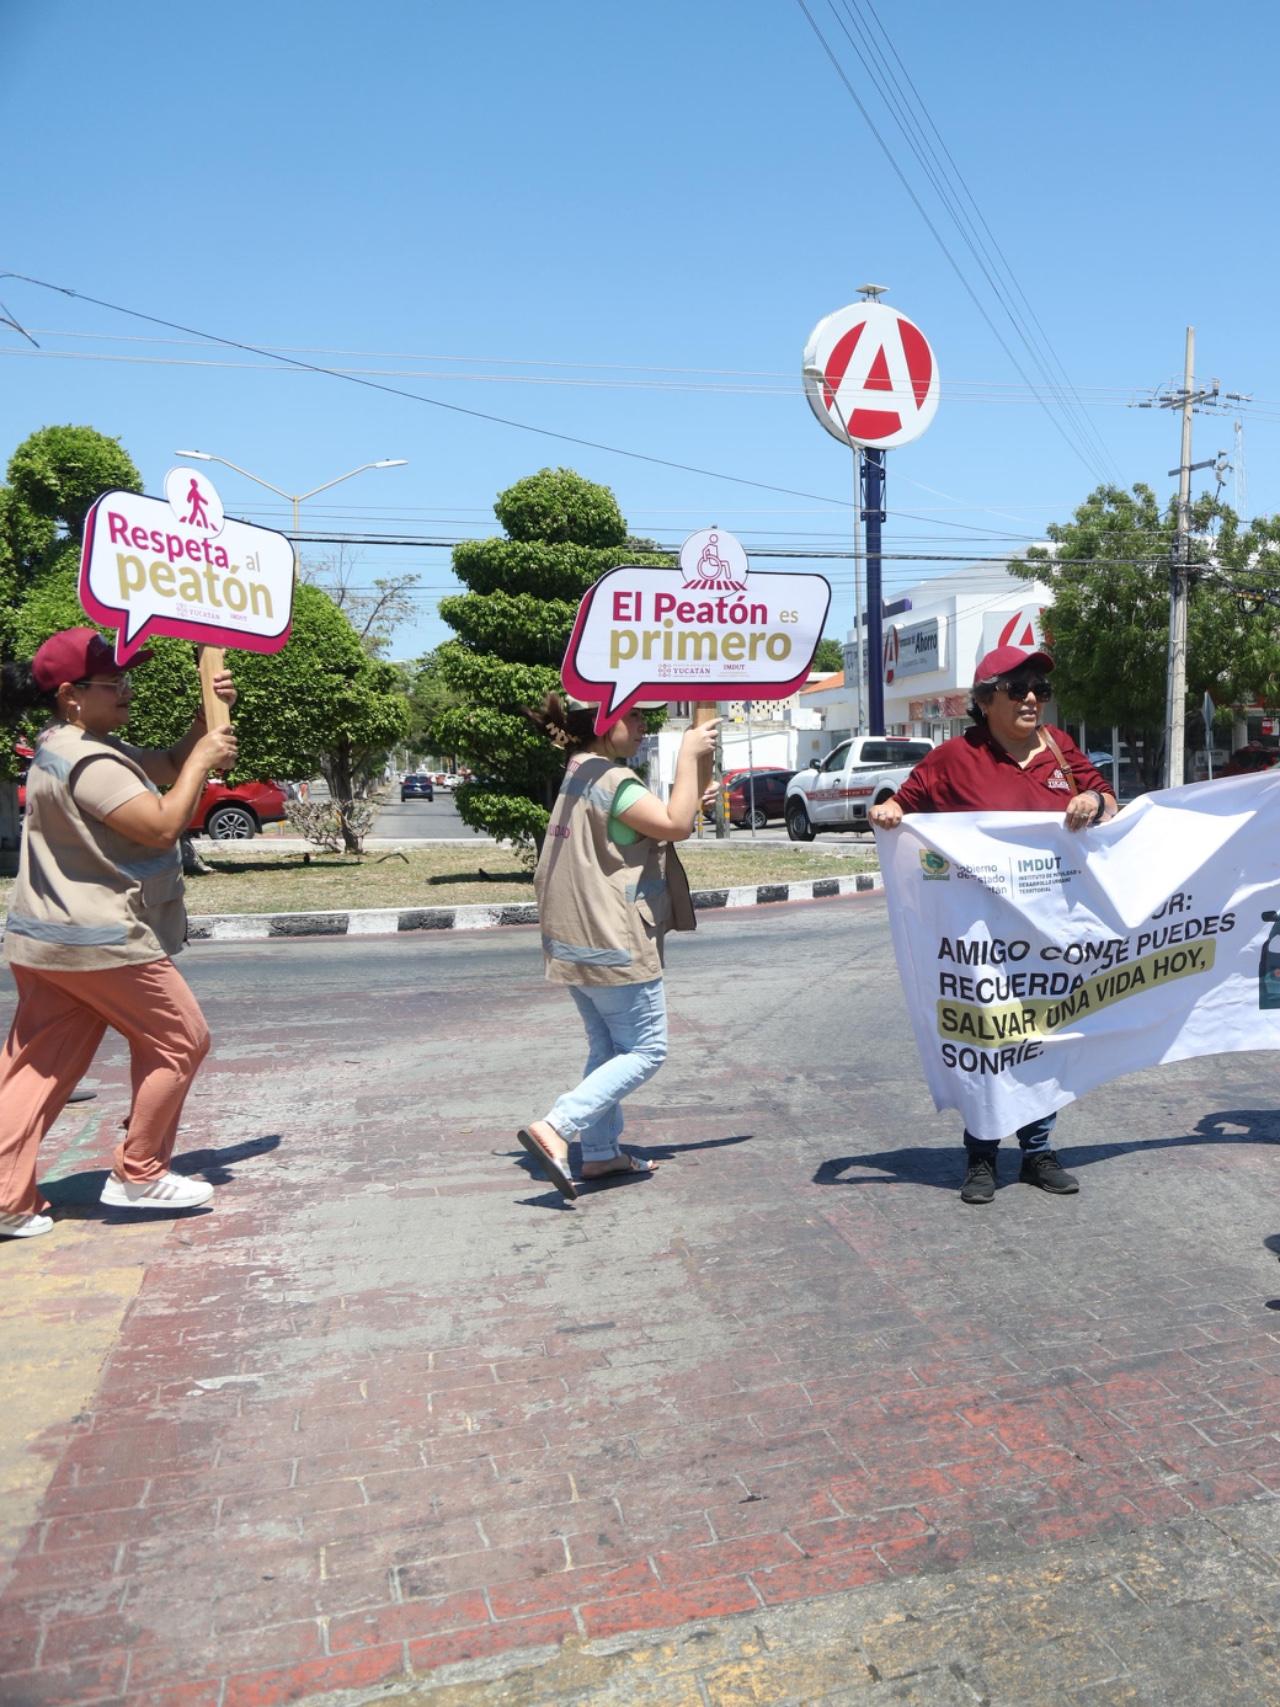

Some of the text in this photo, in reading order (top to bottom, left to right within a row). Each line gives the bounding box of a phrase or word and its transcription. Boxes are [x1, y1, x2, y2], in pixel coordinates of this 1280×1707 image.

[108, 511, 261, 573] Respeta al
[116, 551, 275, 619] peatón
[612, 591, 799, 625] El Peatón es
[610, 619, 793, 669] primero
[955, 857, 1062, 874] obierno IMDUT
[938, 936, 1031, 966] AMIGO
[939, 972, 1084, 1004] RECUERDA
[1136, 913, 1237, 956] PUEDES
[942, 946, 1206, 1041] SALVAR UNA VIDA HOY,
[942, 1038, 1044, 1076] SONRÍE.
